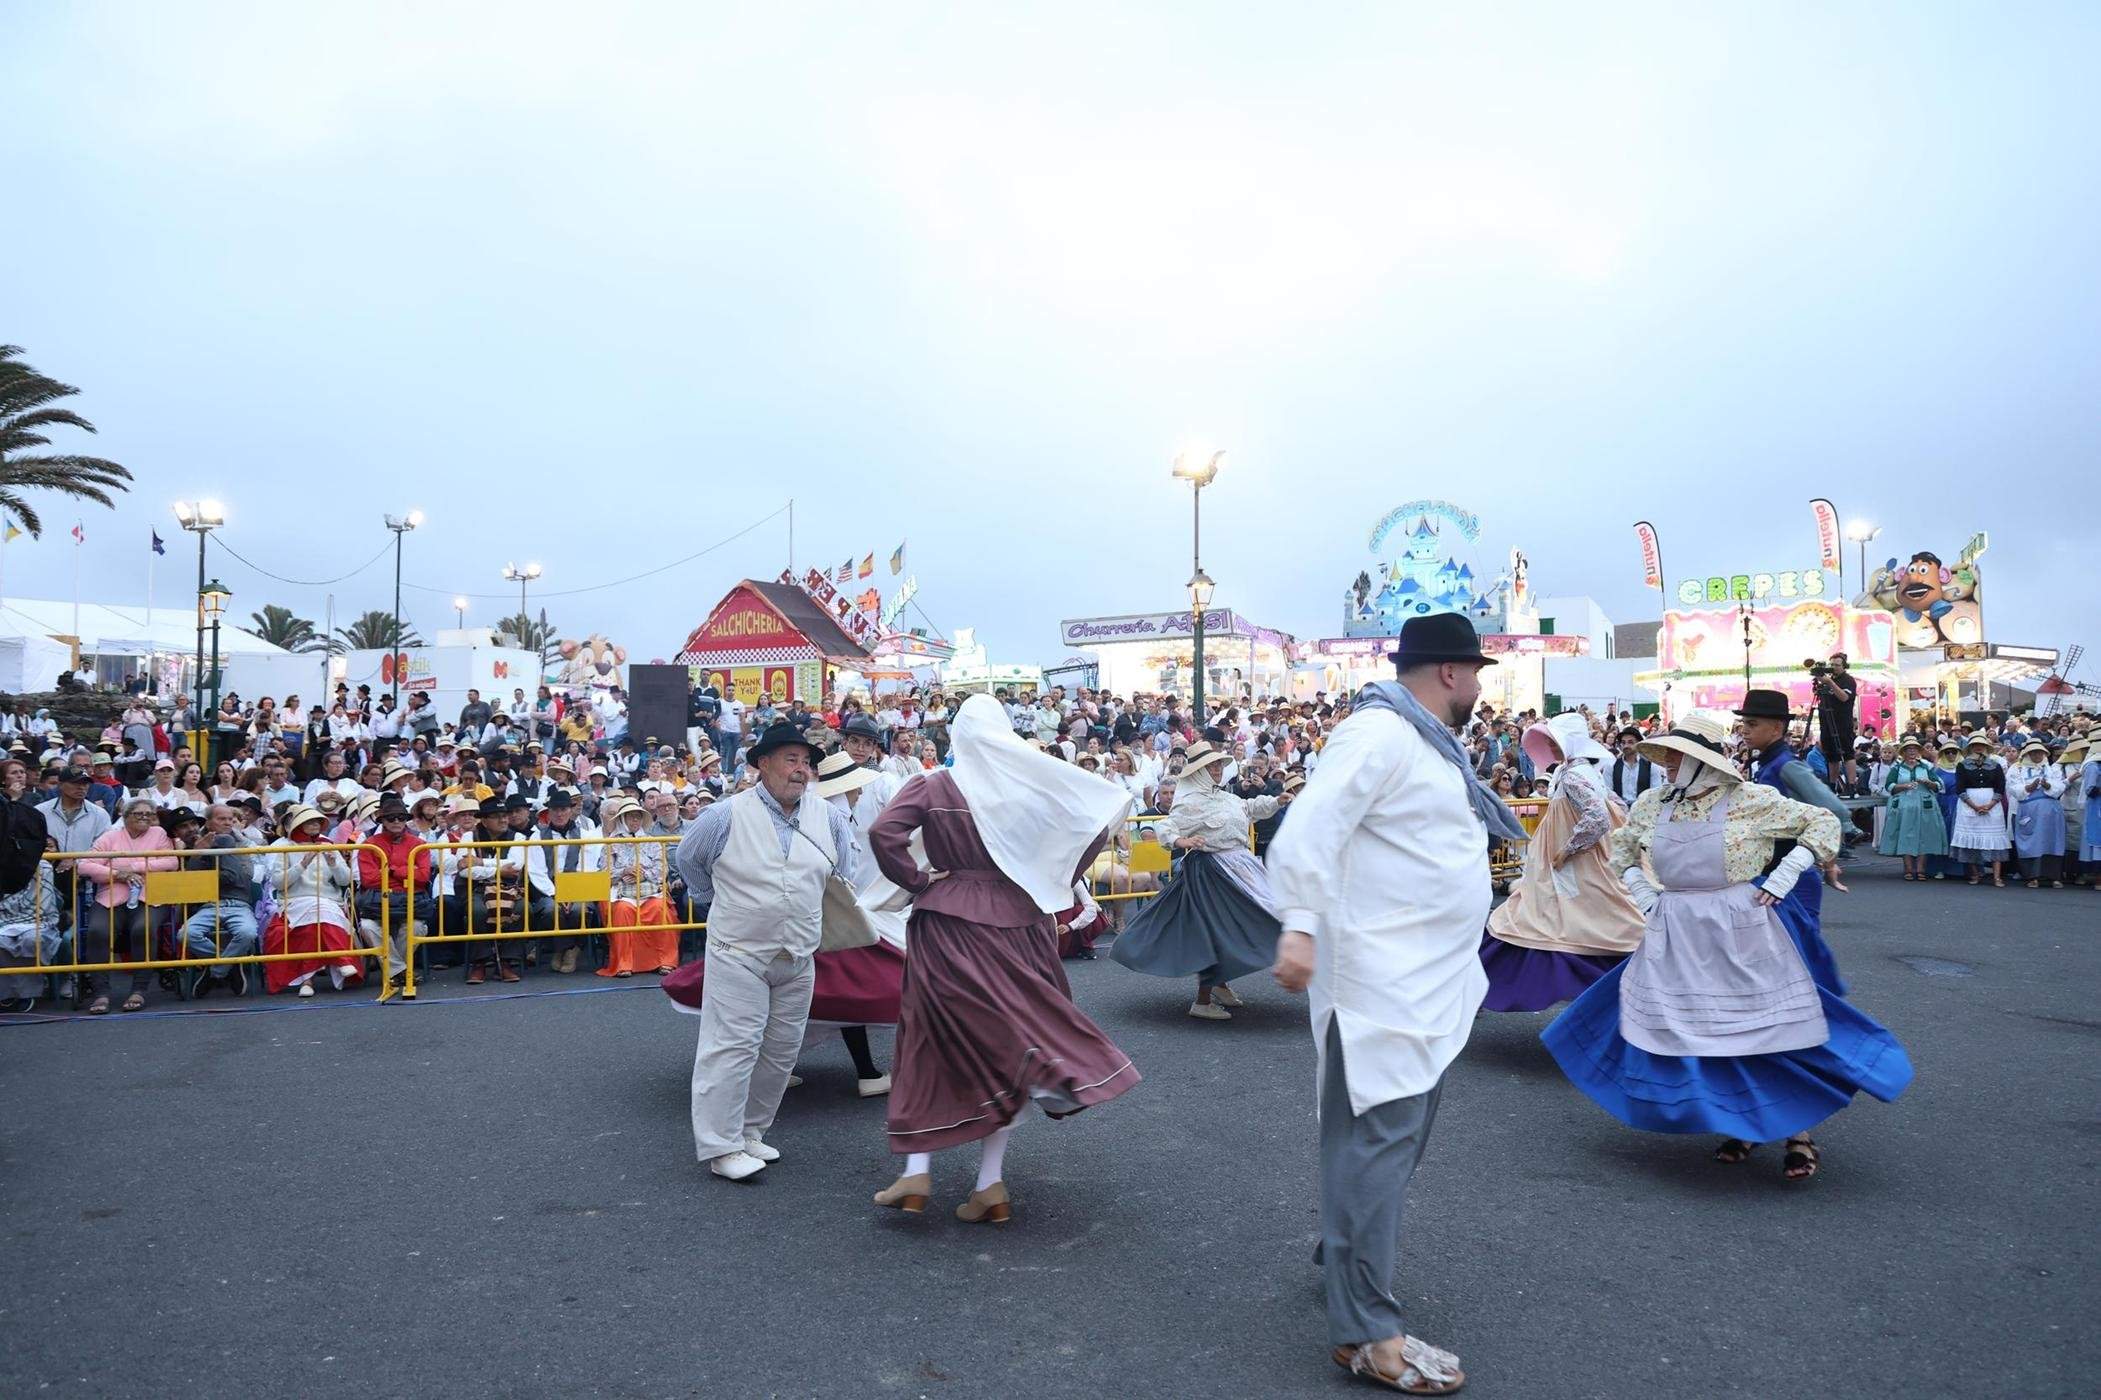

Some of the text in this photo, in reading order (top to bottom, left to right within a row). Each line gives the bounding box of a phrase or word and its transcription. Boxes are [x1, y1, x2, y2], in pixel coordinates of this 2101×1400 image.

[1678, 570, 1824, 604] CREPES
[711, 610, 784, 637] SALCHICHERÍA
[1068, 619, 1155, 638] Churrería
[734, 677, 761, 687] THANK
